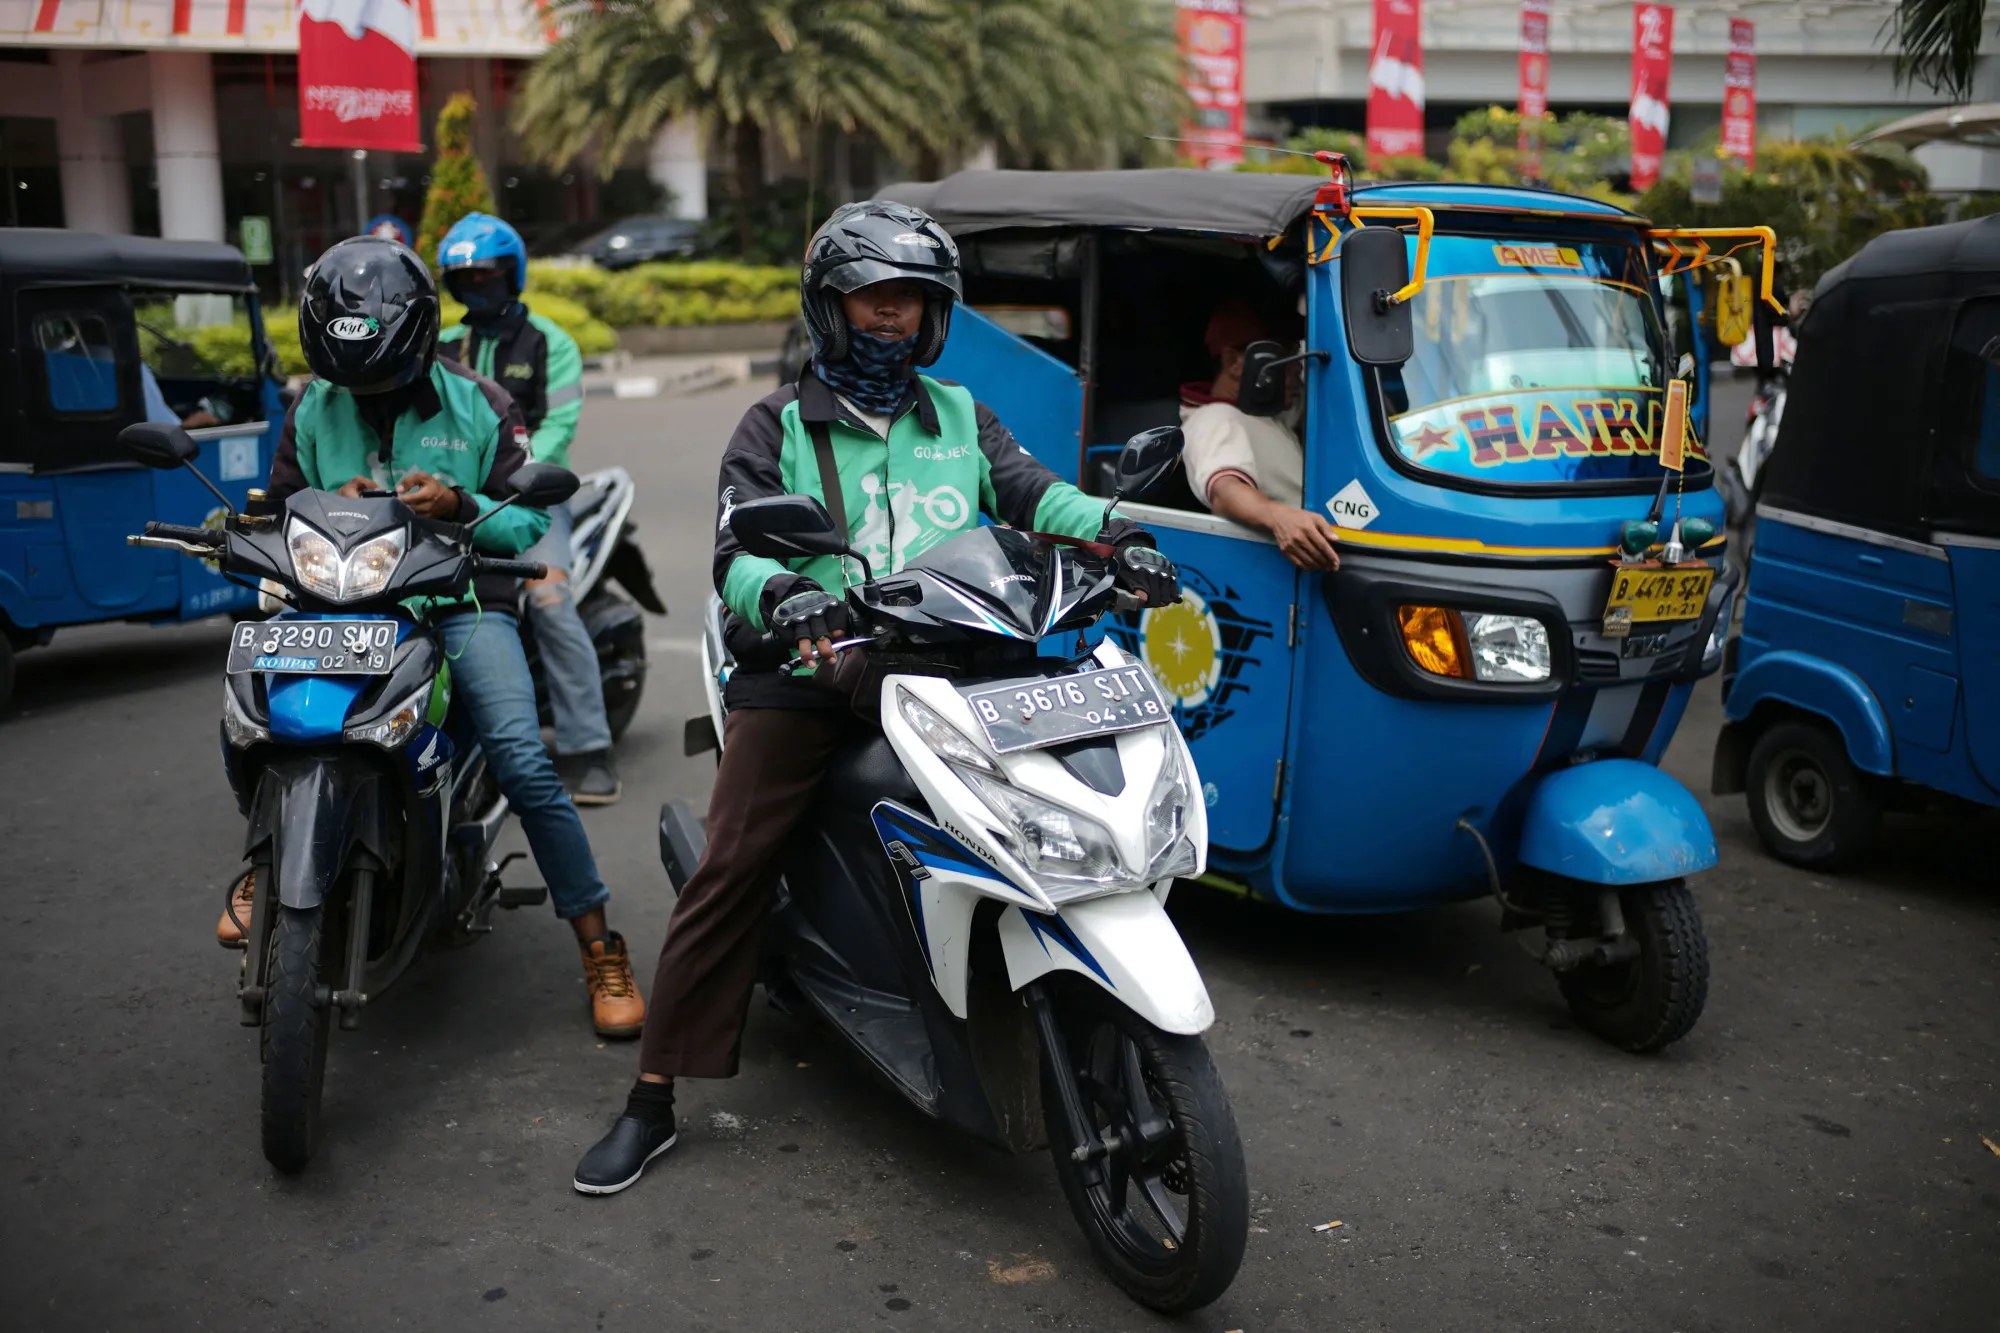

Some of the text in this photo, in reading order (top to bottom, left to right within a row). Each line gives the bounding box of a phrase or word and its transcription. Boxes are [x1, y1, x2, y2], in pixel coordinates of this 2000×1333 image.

[1500, 246, 1581, 267] AMEL
[913, 444, 971, 459] GO JEK
[328, 511, 370, 521] HONDA
[1333, 500, 1370, 518] CNG
[989, 574, 1037, 588] HONDA
[1616, 578, 1629, 600] B
[239, 626, 256, 648] B
[268, 625, 334, 648] 3290
[256, 656, 317, 670] KOMPAS
[976, 669, 1146, 722] B 3676 SIT
[417, 755, 440, 772] HONDA
[943, 819, 1000, 866] HONDA
